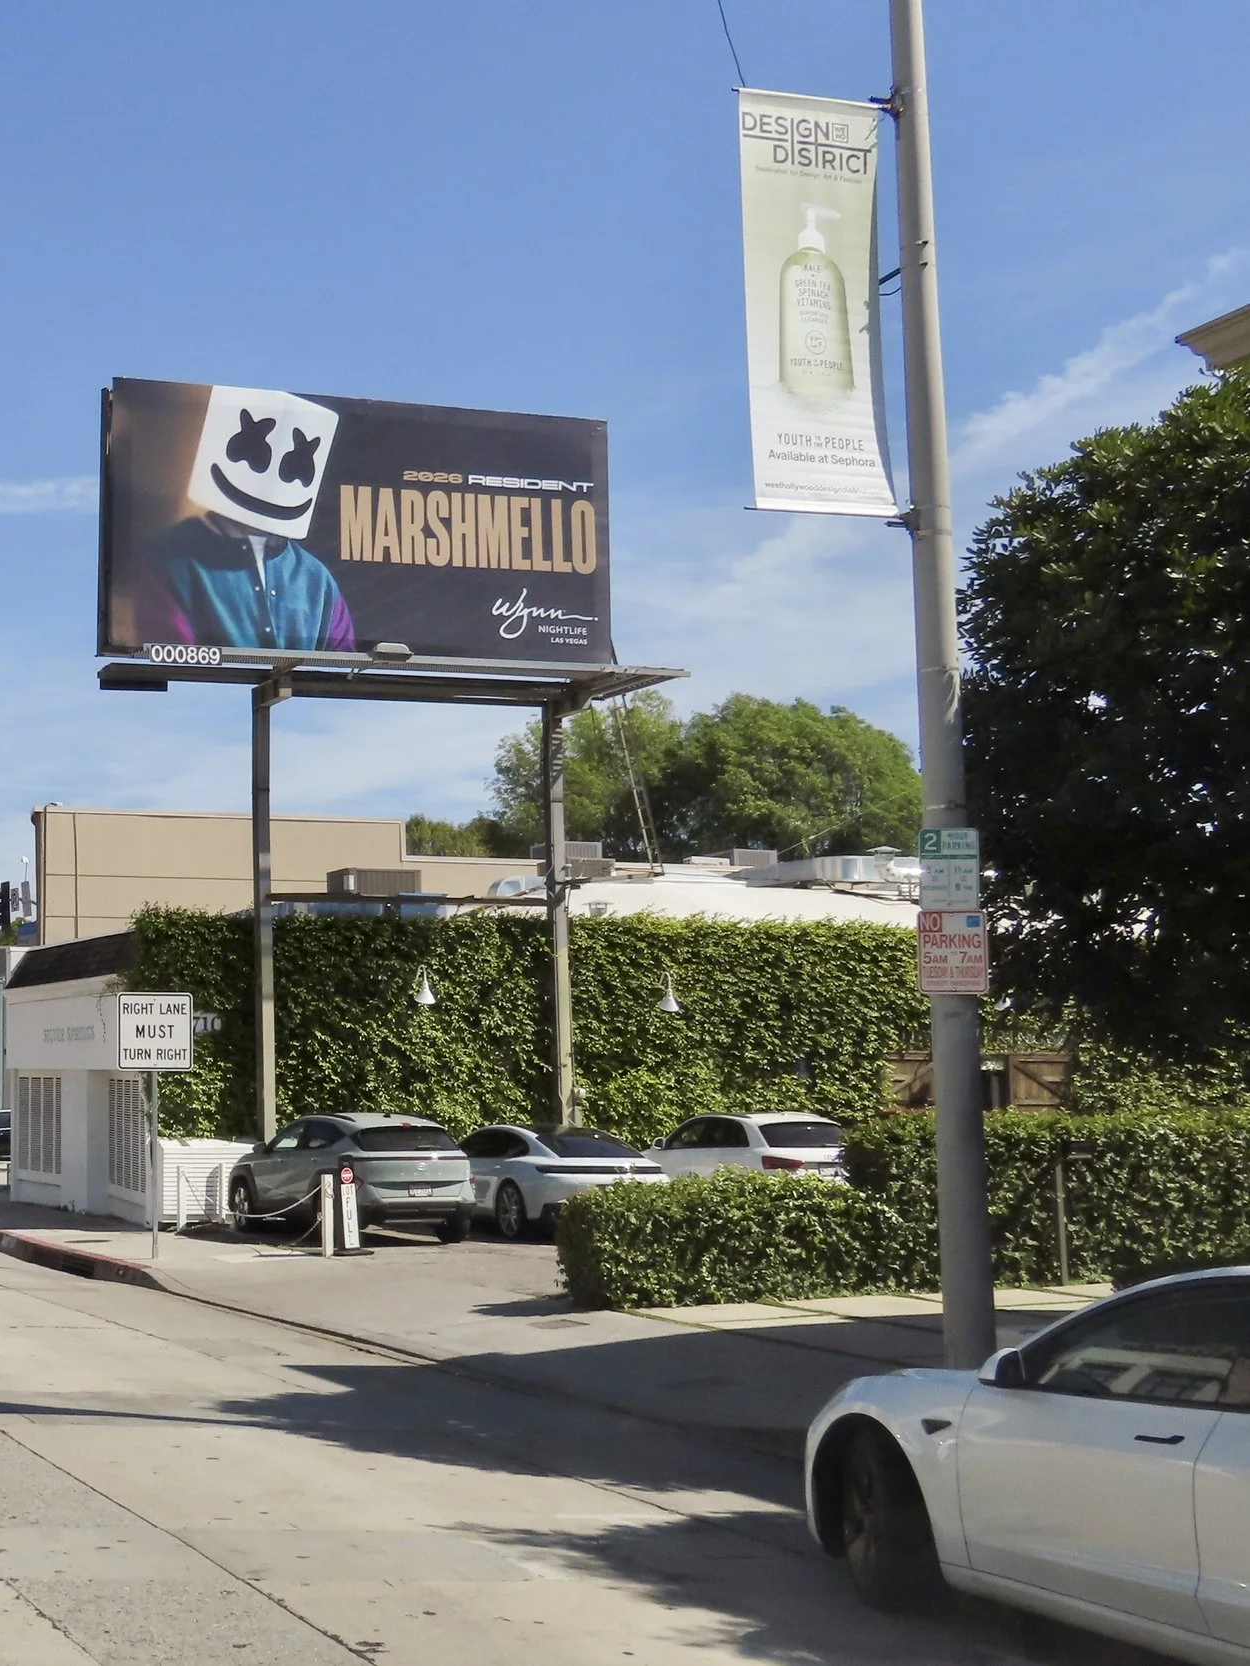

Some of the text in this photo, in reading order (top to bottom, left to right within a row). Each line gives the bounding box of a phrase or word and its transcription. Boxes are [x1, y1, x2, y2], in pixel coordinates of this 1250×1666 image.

[741, 111, 830, 142] DESIGN
[772, 144, 872, 175] DISTRICT
[777, 432, 812, 447] YOUTH
[824, 436, 865, 452] PEOPLE
[768, 449, 876, 468] Available at Sephora
[402, 470, 594, 493] 2026 RESIDENT
[340, 484, 598, 575] MARSHMELLO
[537, 624, 588, 636] NIGHTLIFE
[550, 636, 588, 645] LAS VEGAS
[150, 644, 221, 665] 000869
[924, 832, 937, 851] 2
[920, 913, 940, 931] NO
[923, 933, 982, 949] PARKING
[923, 951, 983, 964] 5AM 7AM
[122, 1002, 188, 1016] RIGHT LANE
[135, 1024, 175, 1039] MUST
[122, 1048, 188, 1061] TURN RIGHT
[342, 1185, 354, 1196] LOT
